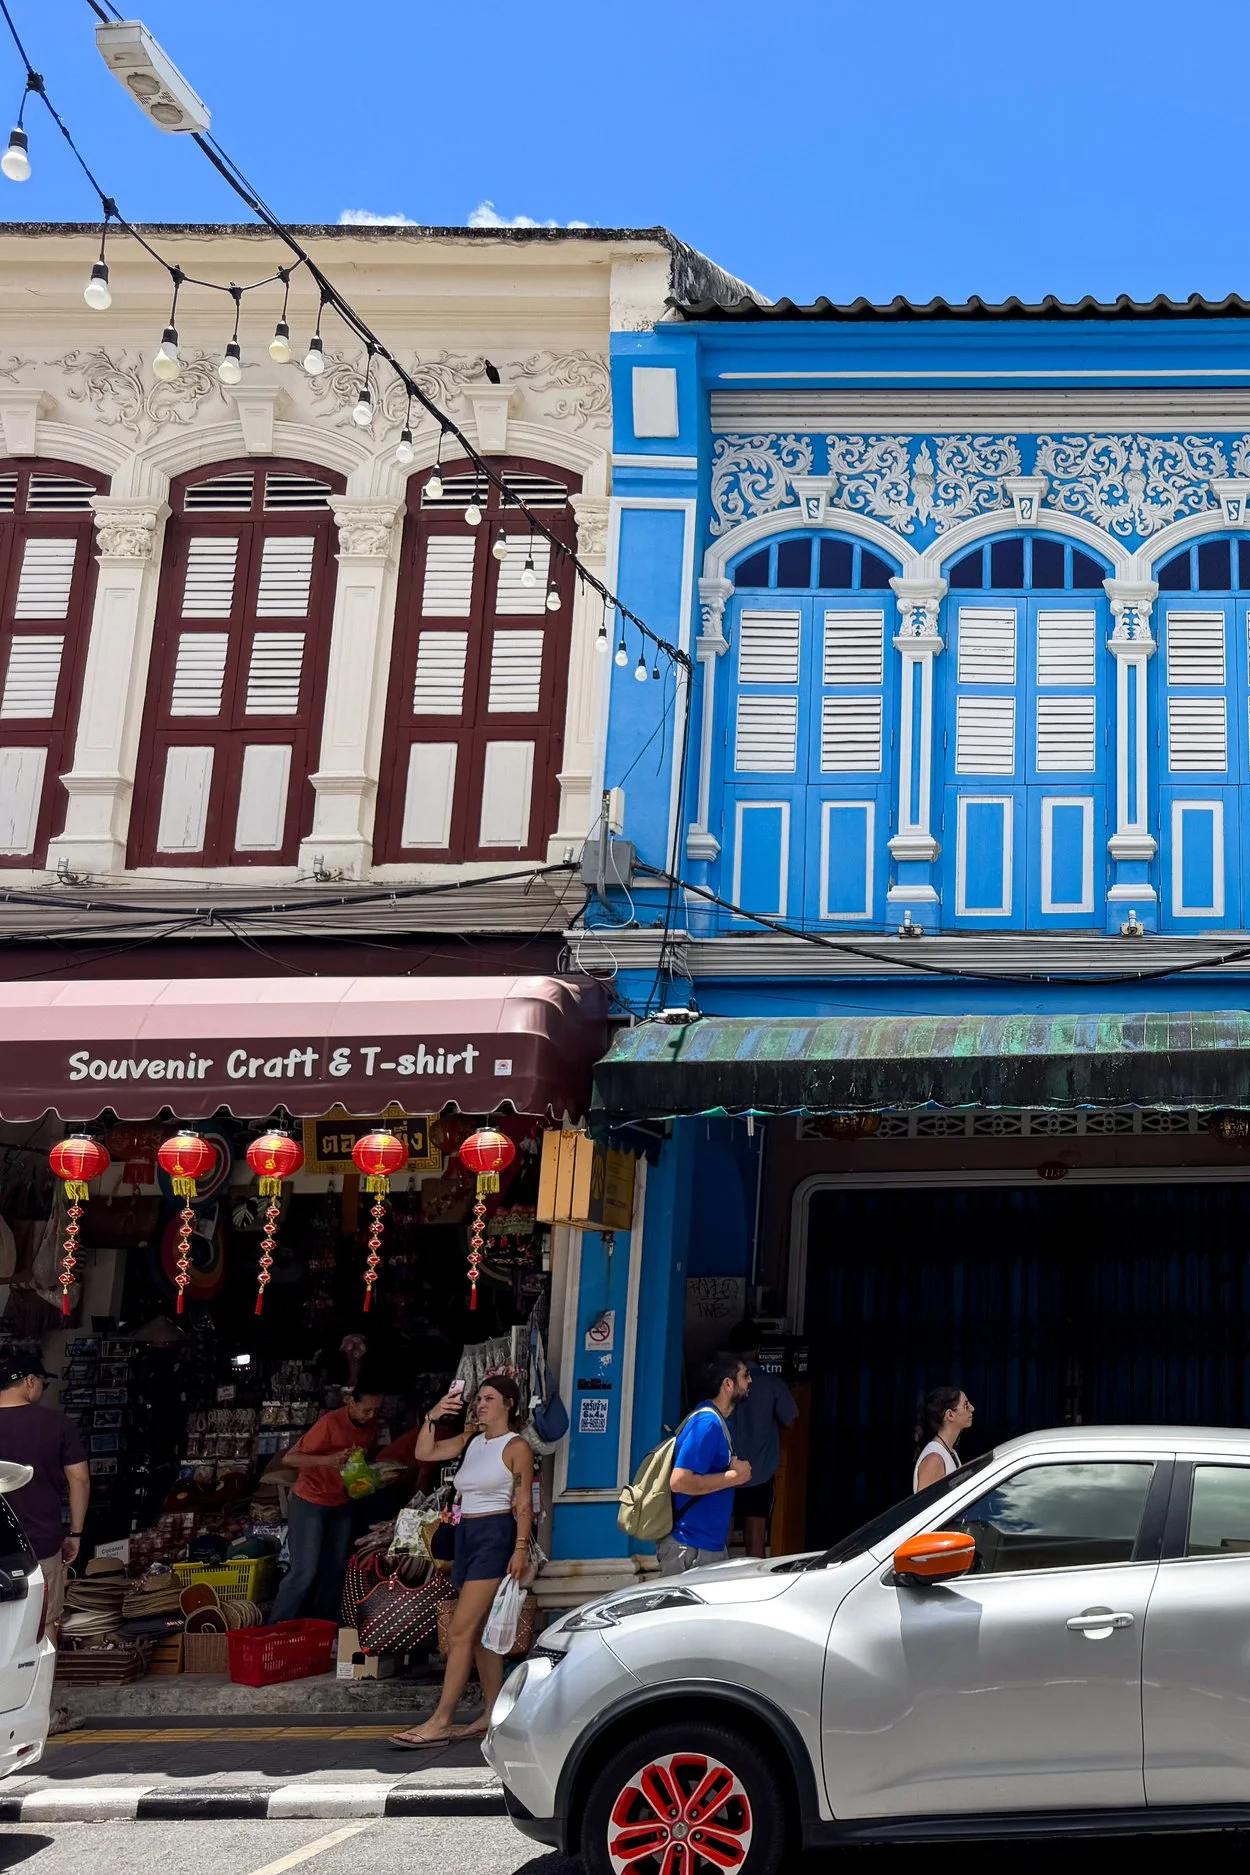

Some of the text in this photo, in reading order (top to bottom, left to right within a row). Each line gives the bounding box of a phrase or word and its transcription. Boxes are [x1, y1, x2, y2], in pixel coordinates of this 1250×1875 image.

[68, 1043, 480, 1081] Souvenir Craft & T-shirt
